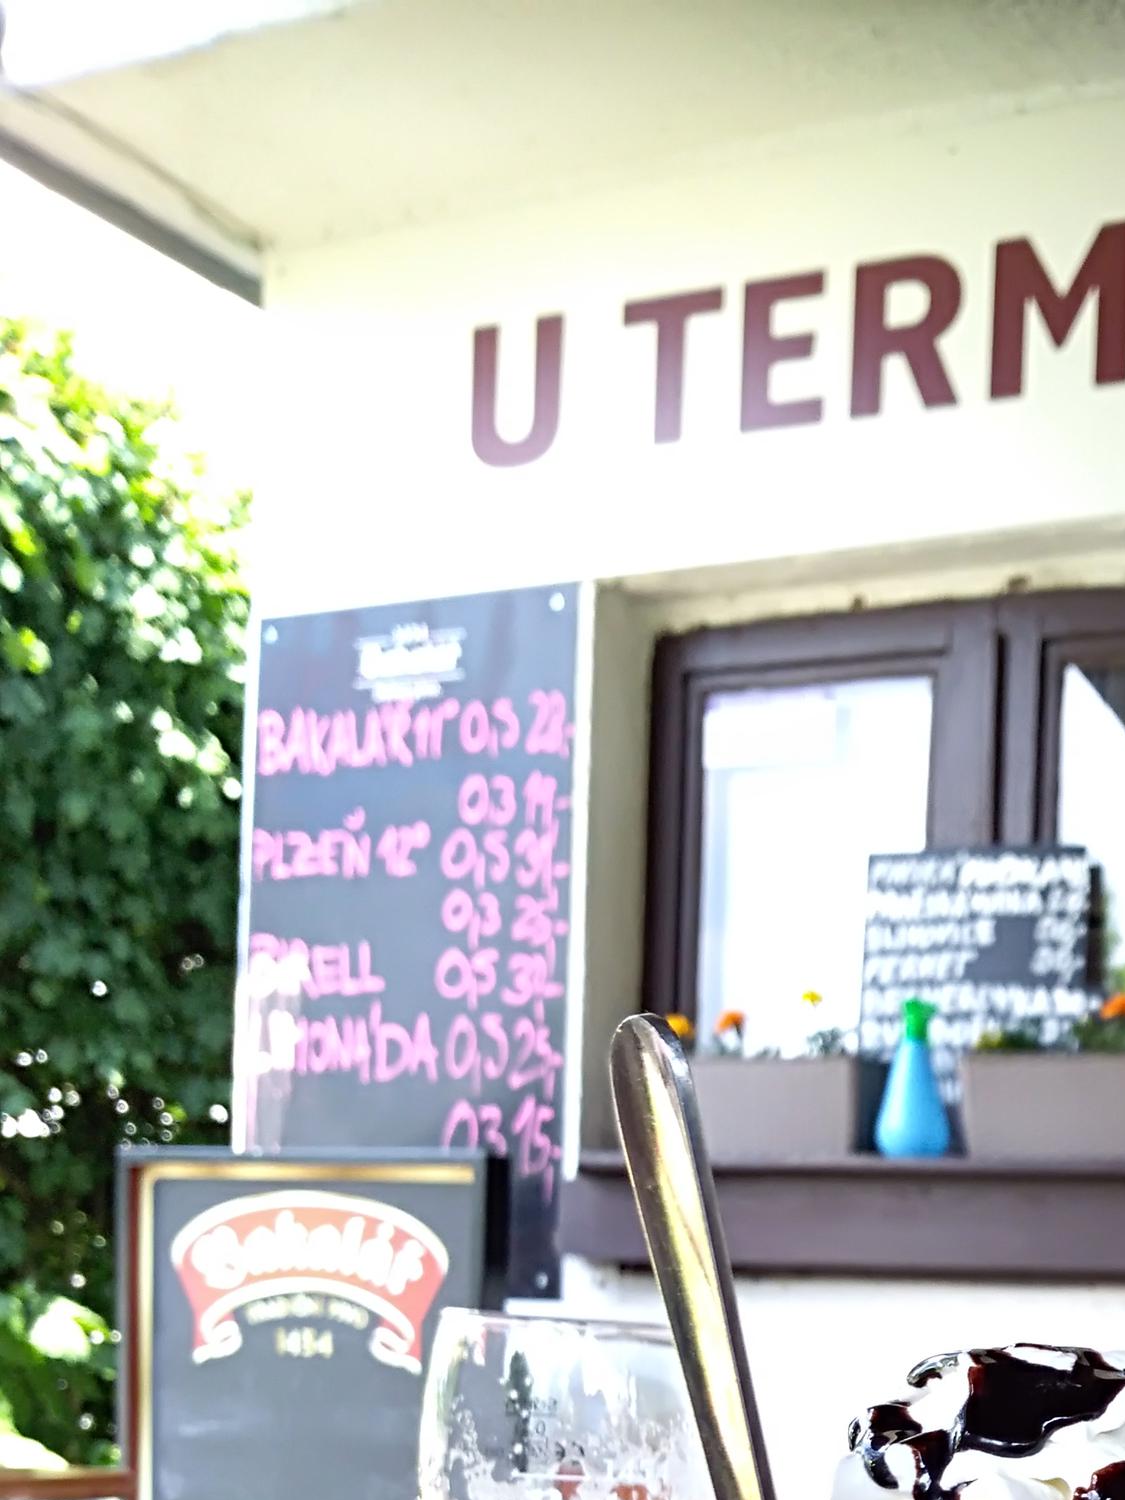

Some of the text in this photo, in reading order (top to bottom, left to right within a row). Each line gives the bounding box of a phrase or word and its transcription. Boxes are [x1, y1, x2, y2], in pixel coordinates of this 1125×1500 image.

[472, 312, 564, 467] U
[440, 827, 511, 888] 0,5
[441, 888, 501, 947] 0,3
